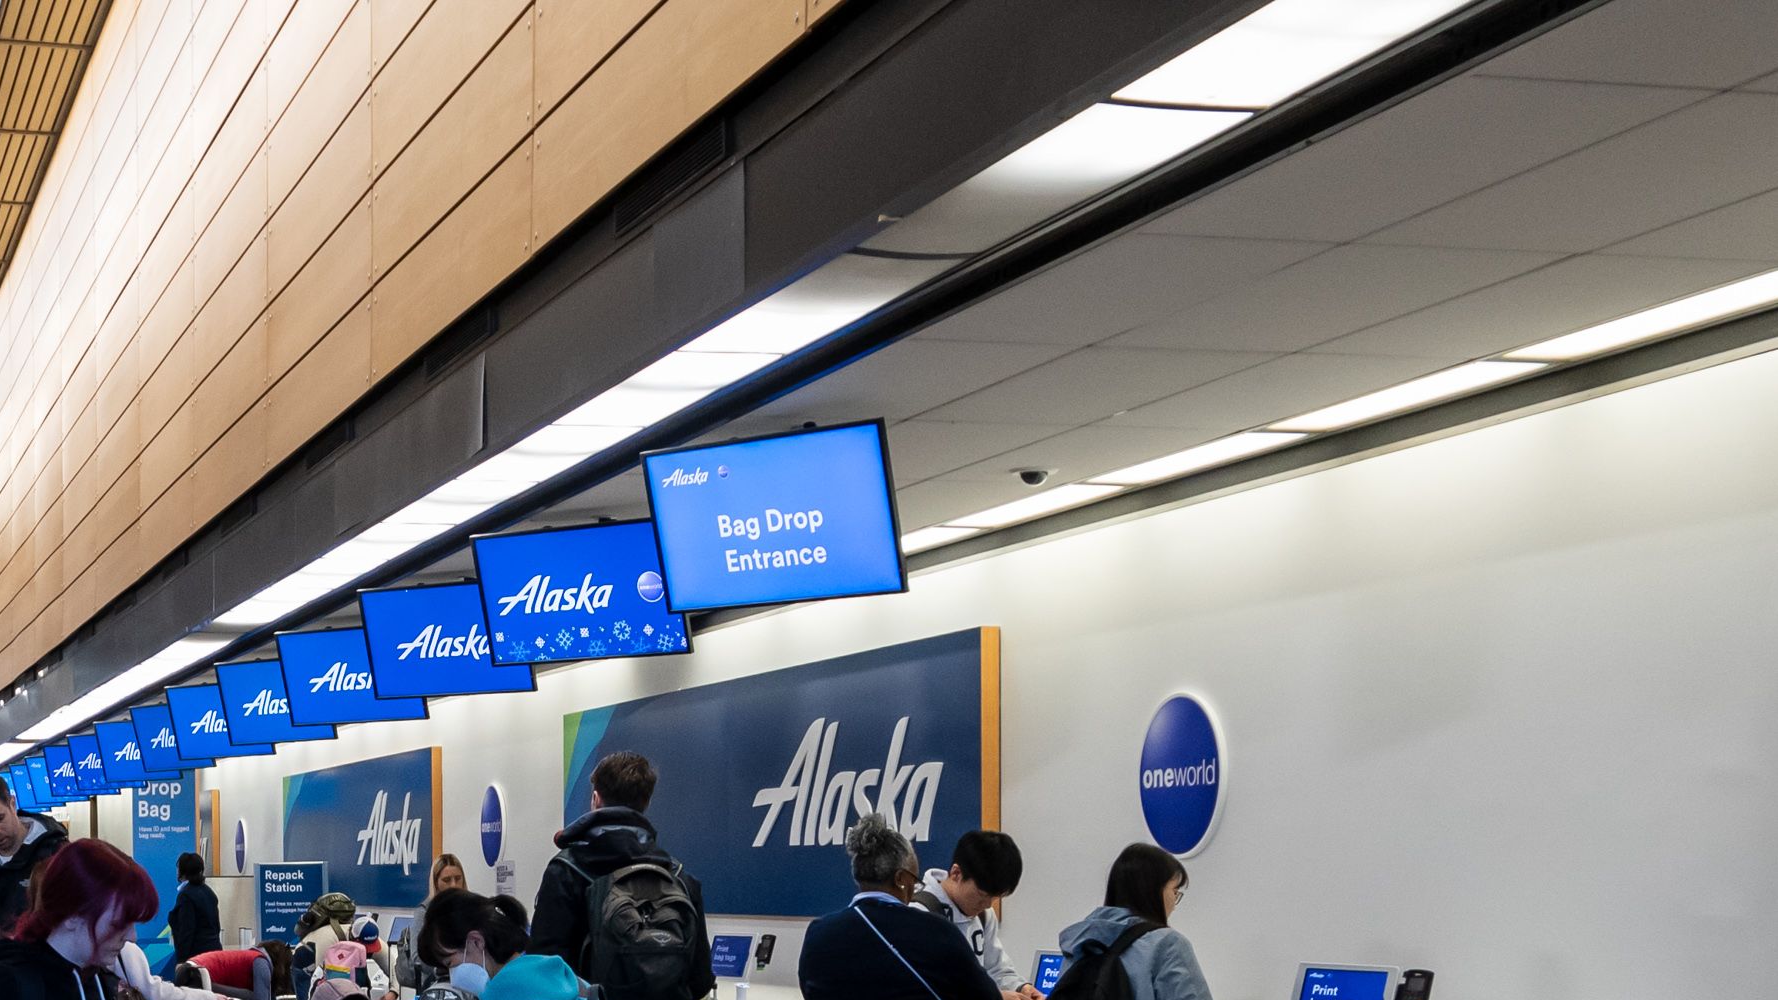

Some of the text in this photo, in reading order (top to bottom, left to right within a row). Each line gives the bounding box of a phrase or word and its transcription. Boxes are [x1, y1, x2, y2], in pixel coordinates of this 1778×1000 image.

[662, 466, 709, 488] Alaska
[717, 508, 824, 540] Bag Drop
[725, 546, 828, 573] Entrance
[498, 573, 614, 616] Alaska
[242, 689, 289, 716] Alas
[150, 727, 177, 749] Ala
[78, 752, 102, 770] Ala
[752, 716, 944, 847] Alaska
[1142, 757, 1216, 790] oneworld
[138, 800, 171, 821] Bag
[356, 789, 422, 876] Alaska
[265, 869, 304, 882] Repack
[265, 882, 302, 892] Station
[1312, 984, 1338, 996] Print
